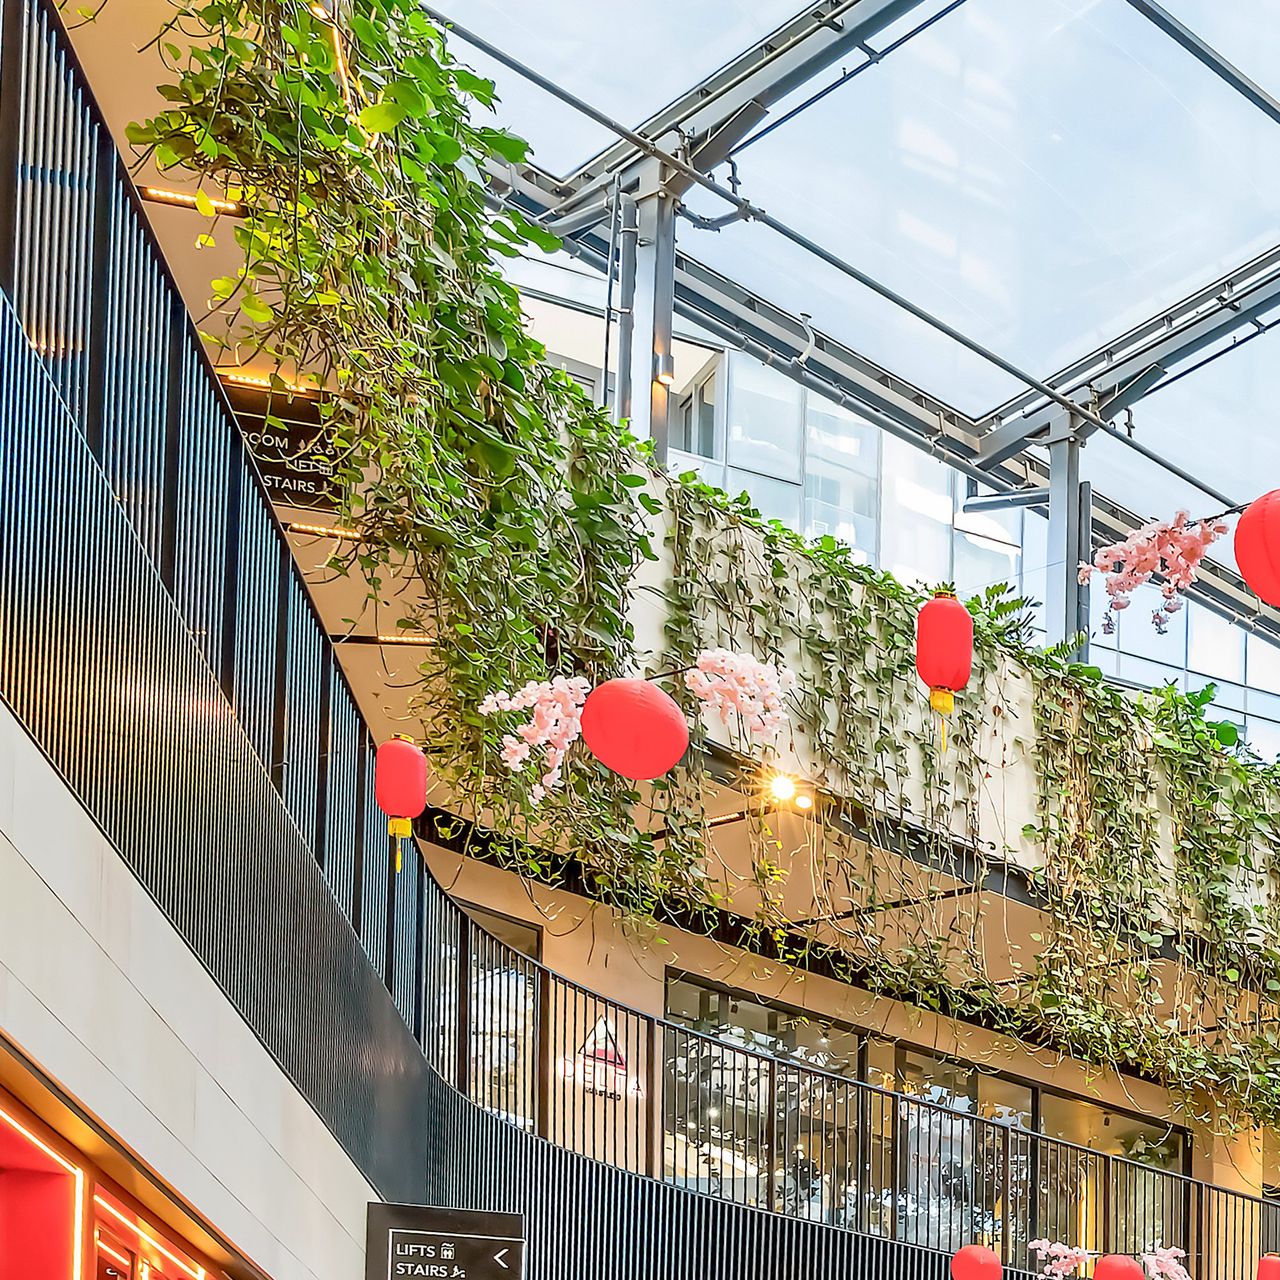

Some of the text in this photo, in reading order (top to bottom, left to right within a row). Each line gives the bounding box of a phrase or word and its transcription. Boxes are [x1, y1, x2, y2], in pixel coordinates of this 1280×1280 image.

[263, 475, 315, 493] STAIRS
[396, 1243, 436, 1258] LIFTS
[396, 1262, 448, 1278] STAIRS
